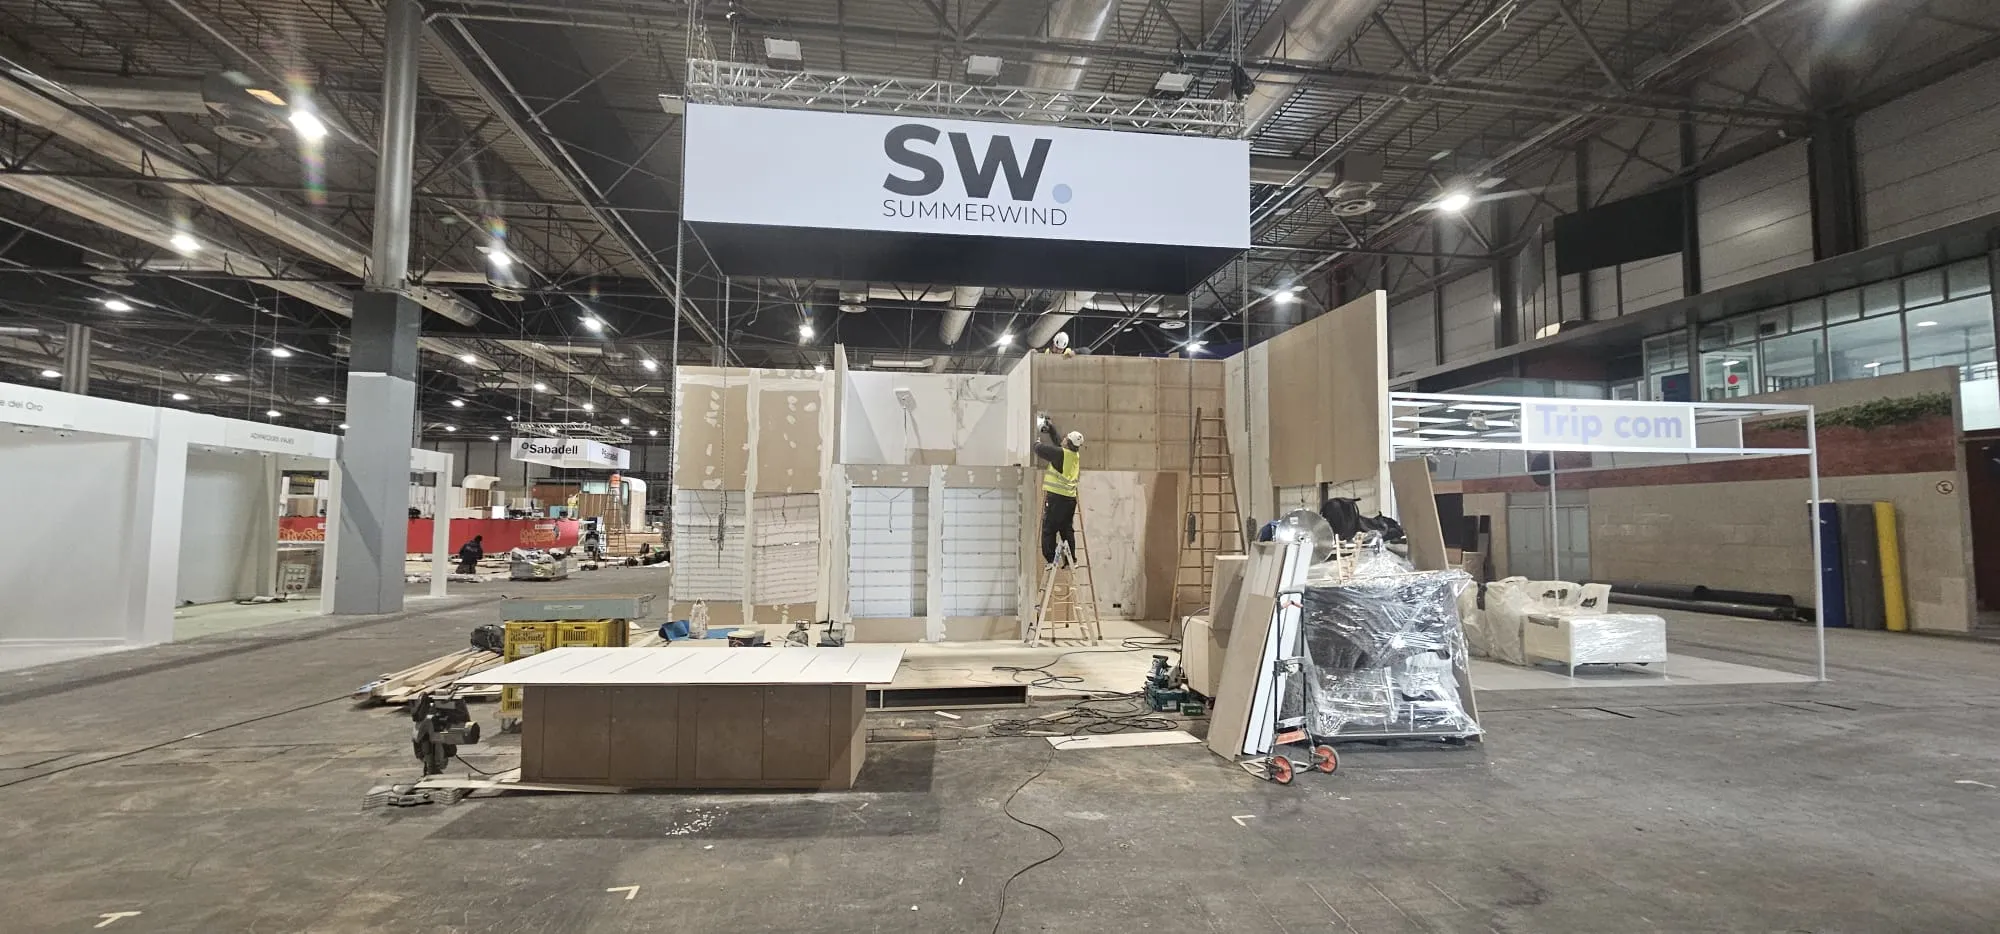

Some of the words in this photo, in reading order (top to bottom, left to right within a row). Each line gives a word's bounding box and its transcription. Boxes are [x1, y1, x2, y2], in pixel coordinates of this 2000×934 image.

[883, 199, 1068, 227] SUMMERWIND
[1536, 403, 1602, 445] Trip
[1614, 415, 1683, 438] com
[529, 444, 578, 455] Sabadell
